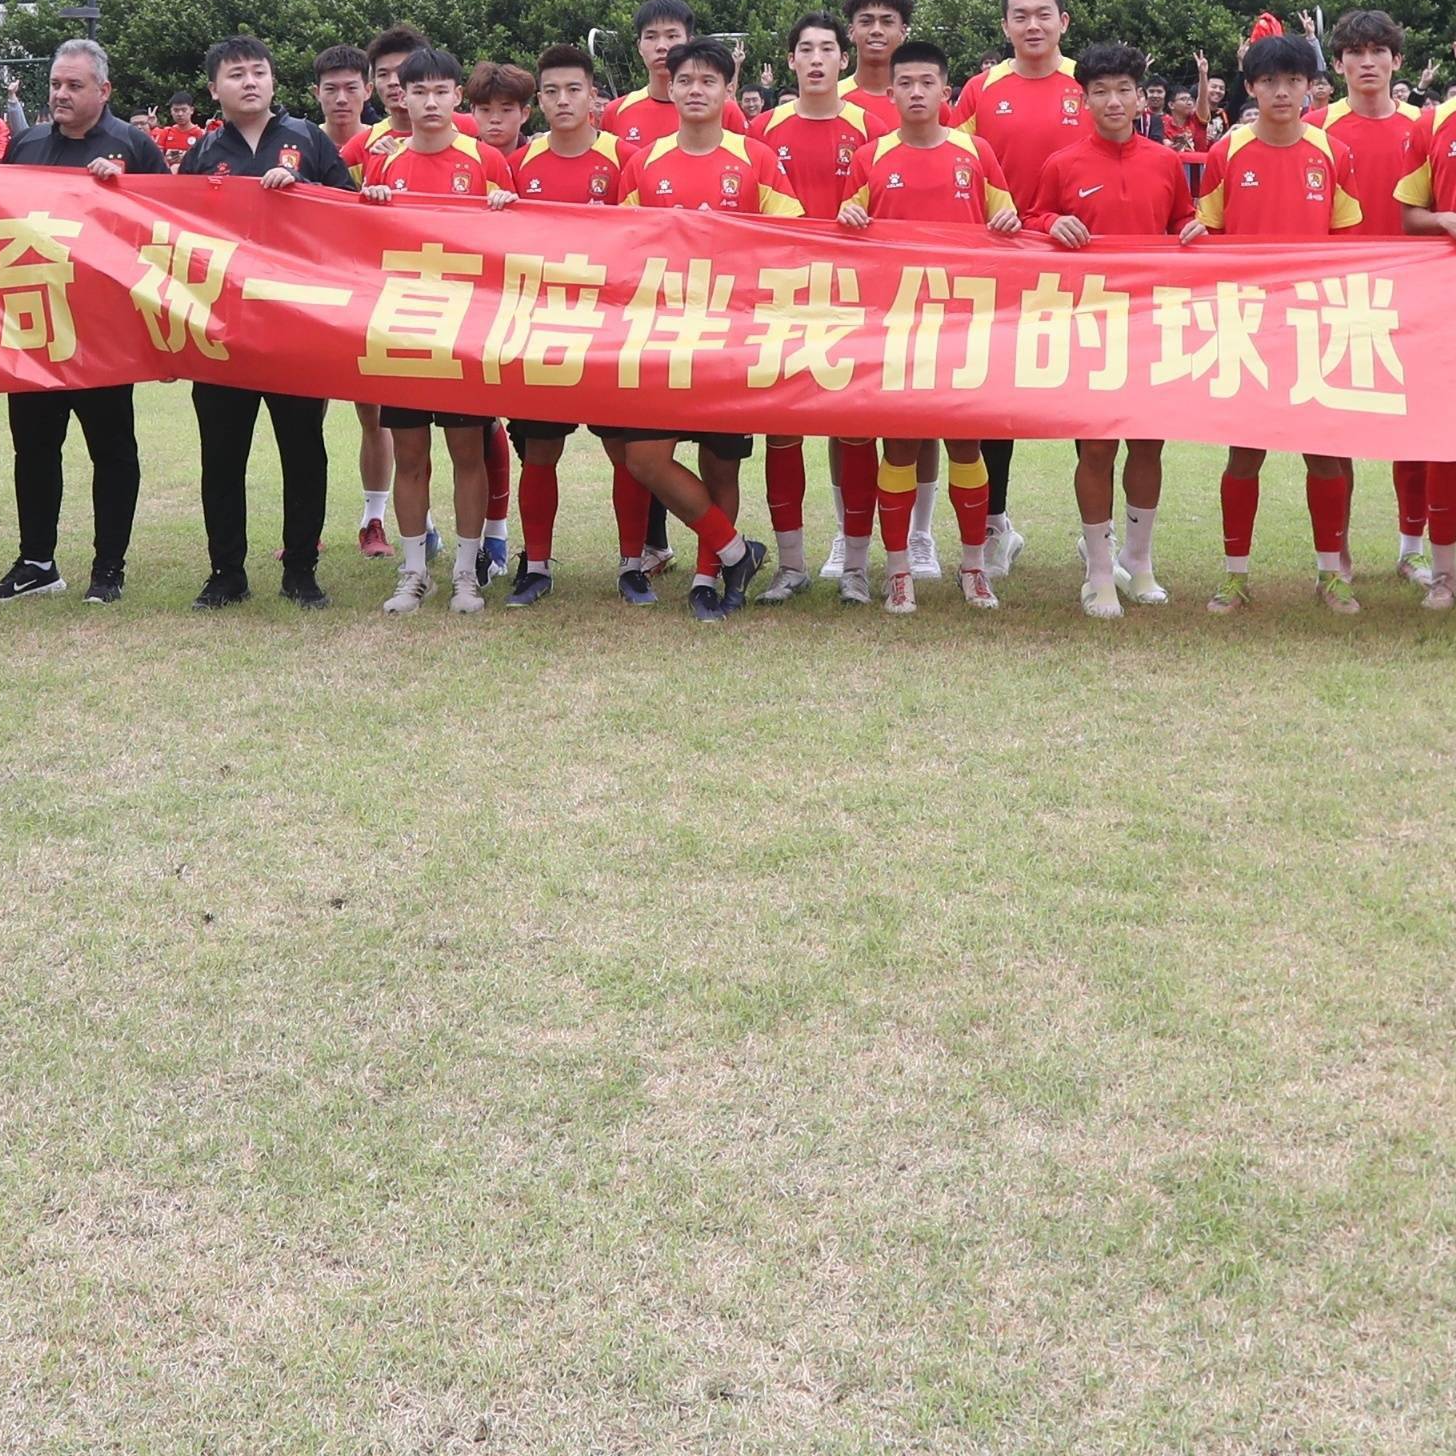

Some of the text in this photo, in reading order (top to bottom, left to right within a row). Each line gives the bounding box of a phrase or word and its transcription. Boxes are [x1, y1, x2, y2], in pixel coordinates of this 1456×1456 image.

[129, 221, 1407, 416] 祝一直陪伴我们的球迷
